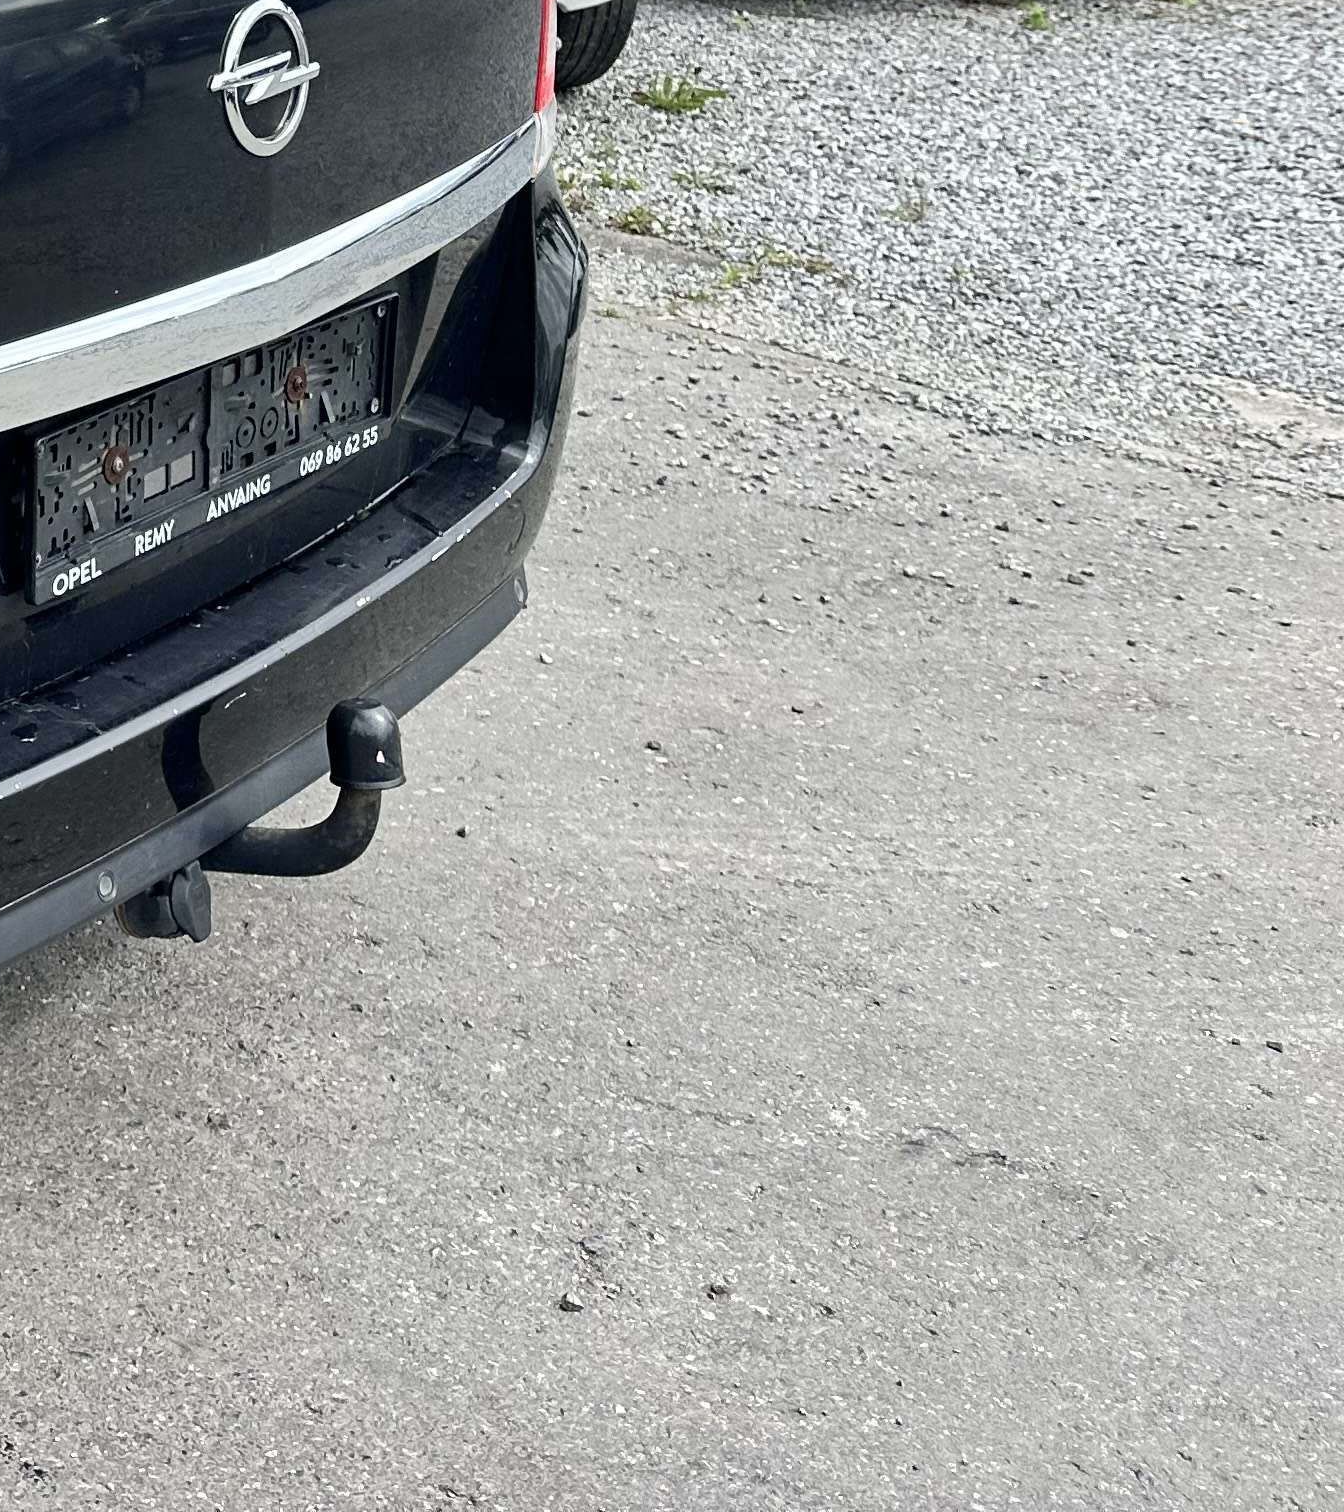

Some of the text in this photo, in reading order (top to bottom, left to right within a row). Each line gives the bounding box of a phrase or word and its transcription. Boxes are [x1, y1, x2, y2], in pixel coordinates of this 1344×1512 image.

[52, 425, 378, 597] OPEL REMY ANVAING 069 86 62 55
